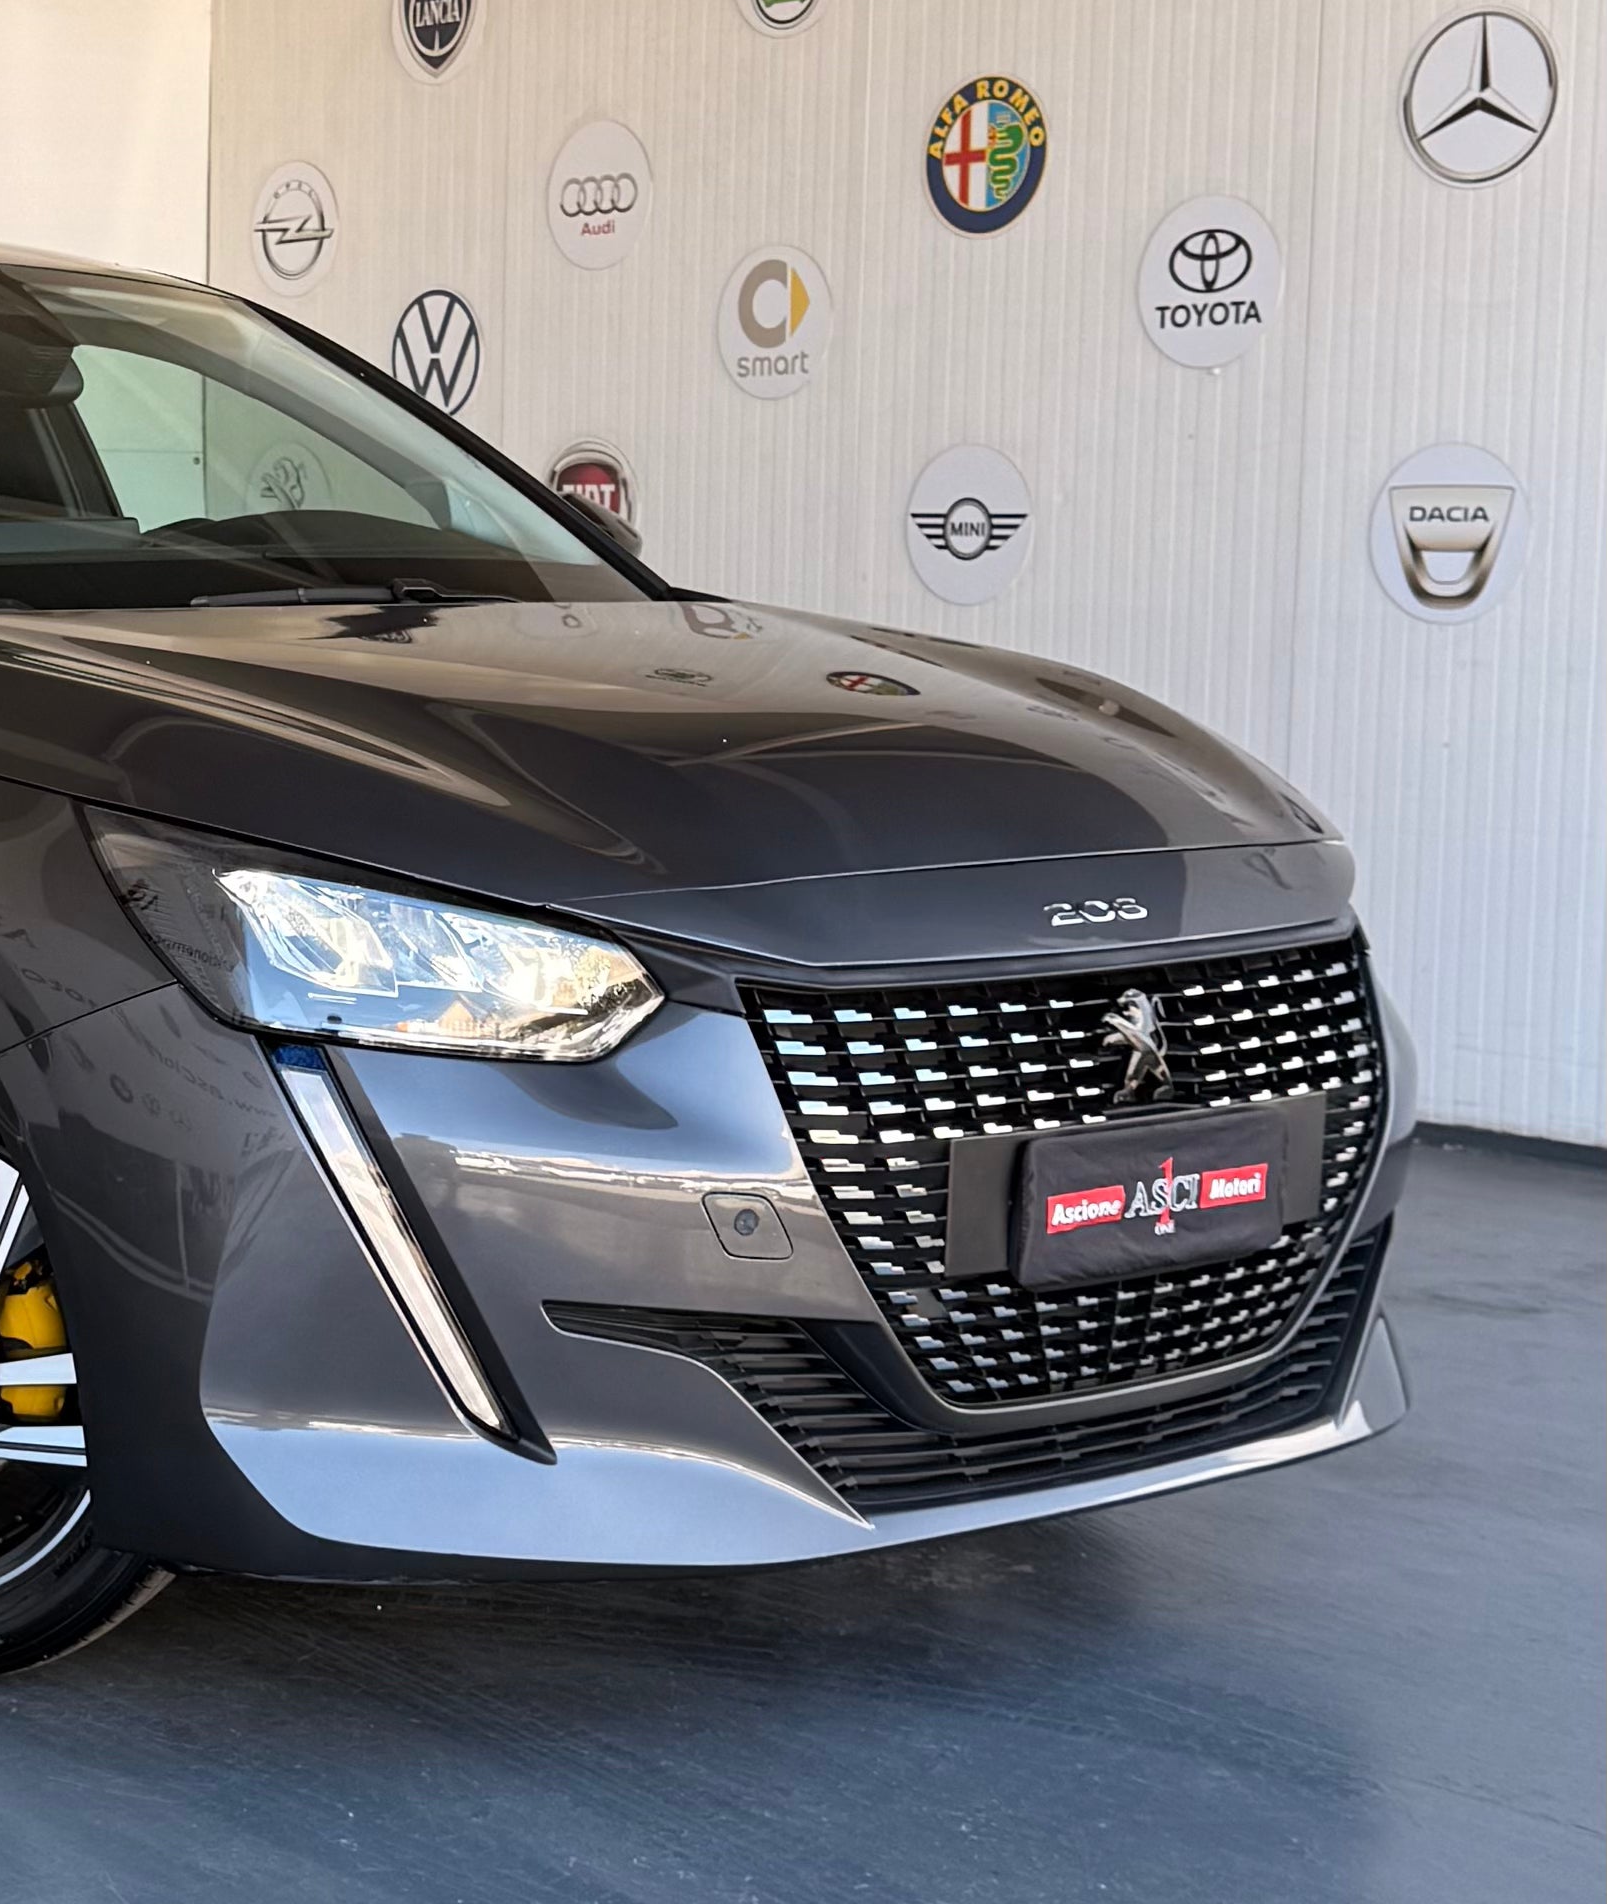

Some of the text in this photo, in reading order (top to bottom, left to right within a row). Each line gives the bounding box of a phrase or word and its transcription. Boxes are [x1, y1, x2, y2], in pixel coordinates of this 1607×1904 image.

[928, 79, 1045, 159] ALFA ROMEO
[581, 219, 616, 236] Audi
[1154, 300, 1262, 329] TOYOTA
[736, 350, 810, 378] smart
[1409, 505, 1490, 523] DACIA
[950, 521, 985, 537] MINI
[1051, 1171, 1263, 1227] Ascione ASCI Motori
